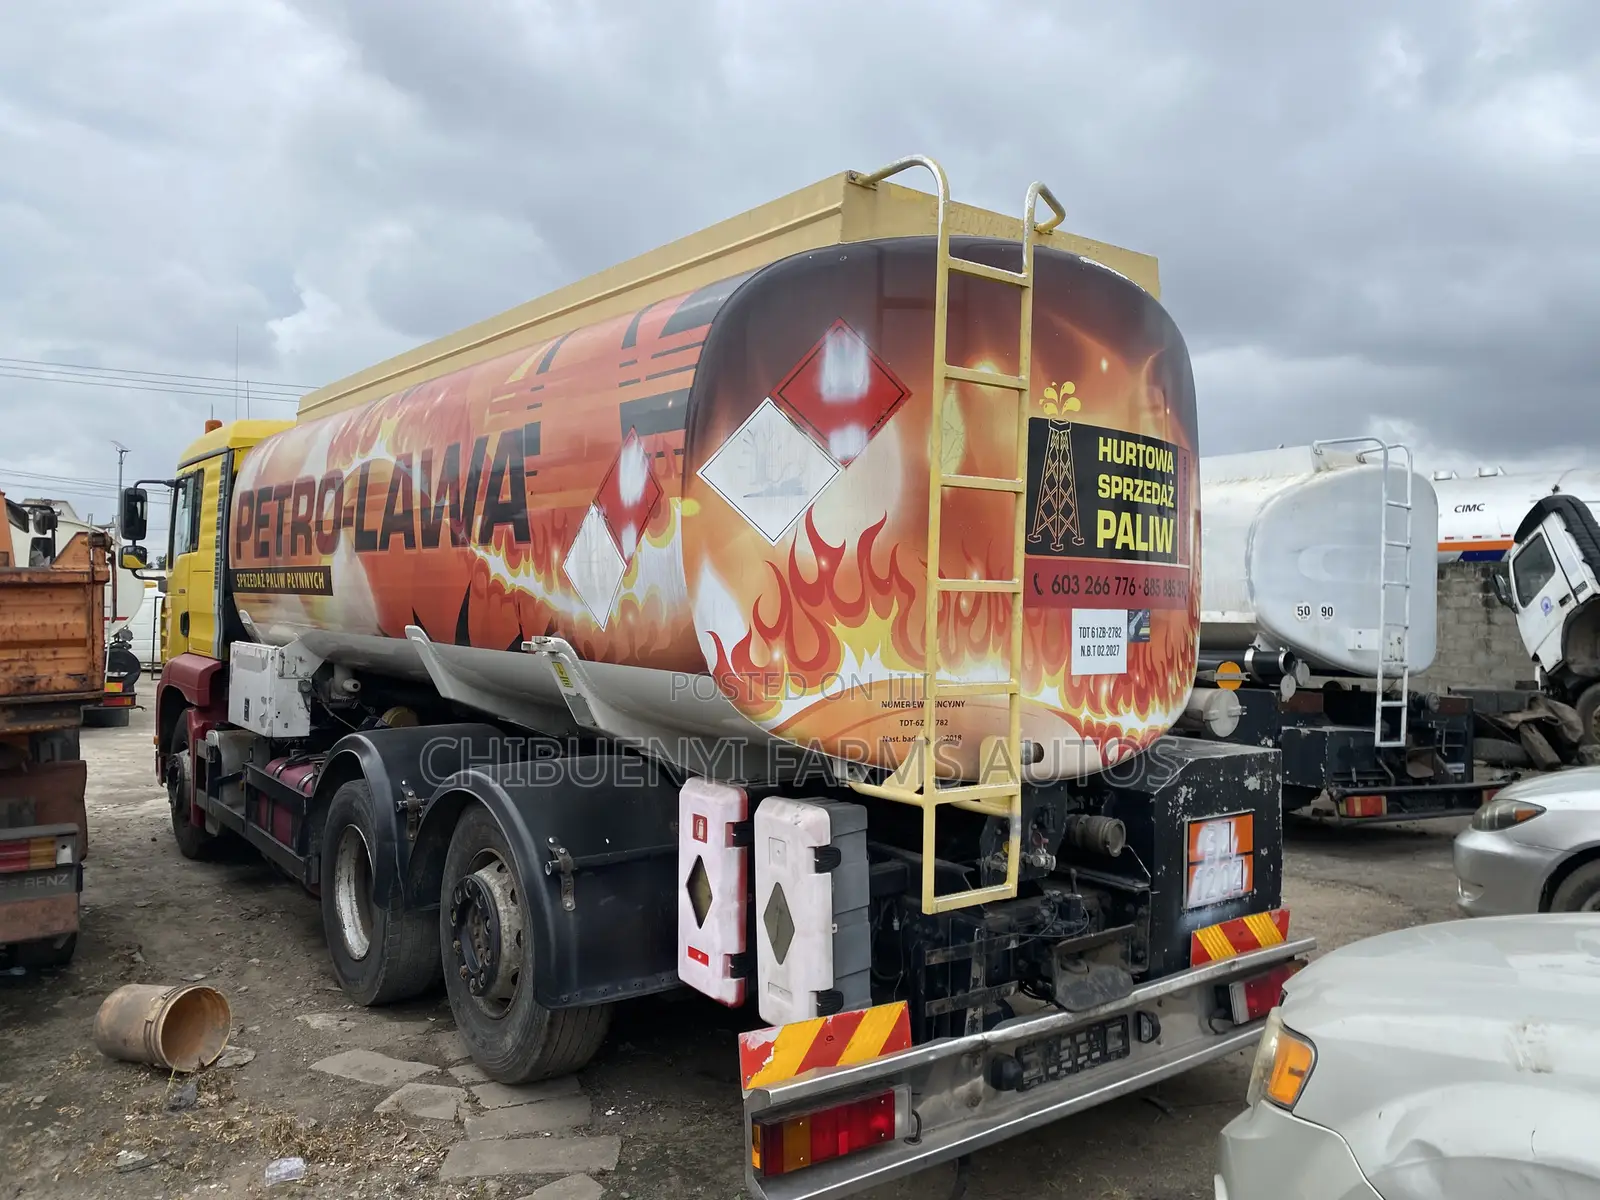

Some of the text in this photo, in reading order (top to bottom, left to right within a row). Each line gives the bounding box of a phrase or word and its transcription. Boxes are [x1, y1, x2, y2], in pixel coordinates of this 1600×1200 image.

[1098, 436, 1175, 475] HURTOWA
[236, 422, 535, 561] PETRO-LAWA
[1097, 473, 1175, 509] SPRZEDAŻ
[1454, 503, 1485, 513] CIMC
[1096, 509, 1174, 553] PALIW
[266, 572, 285, 588] PALIW
[1051, 574, 1080, 595] 603
[1084, 575, 1110, 596] 266
[1115, 576, 1136, 596] 776
[1143, 577, 1161, 597] 885
[1297, 605, 1310, 616] 50
[1321, 606, 1333, 617] 90
[1079, 626, 1090, 639] TDT
[1097, 644, 1120, 657] 02.2027
